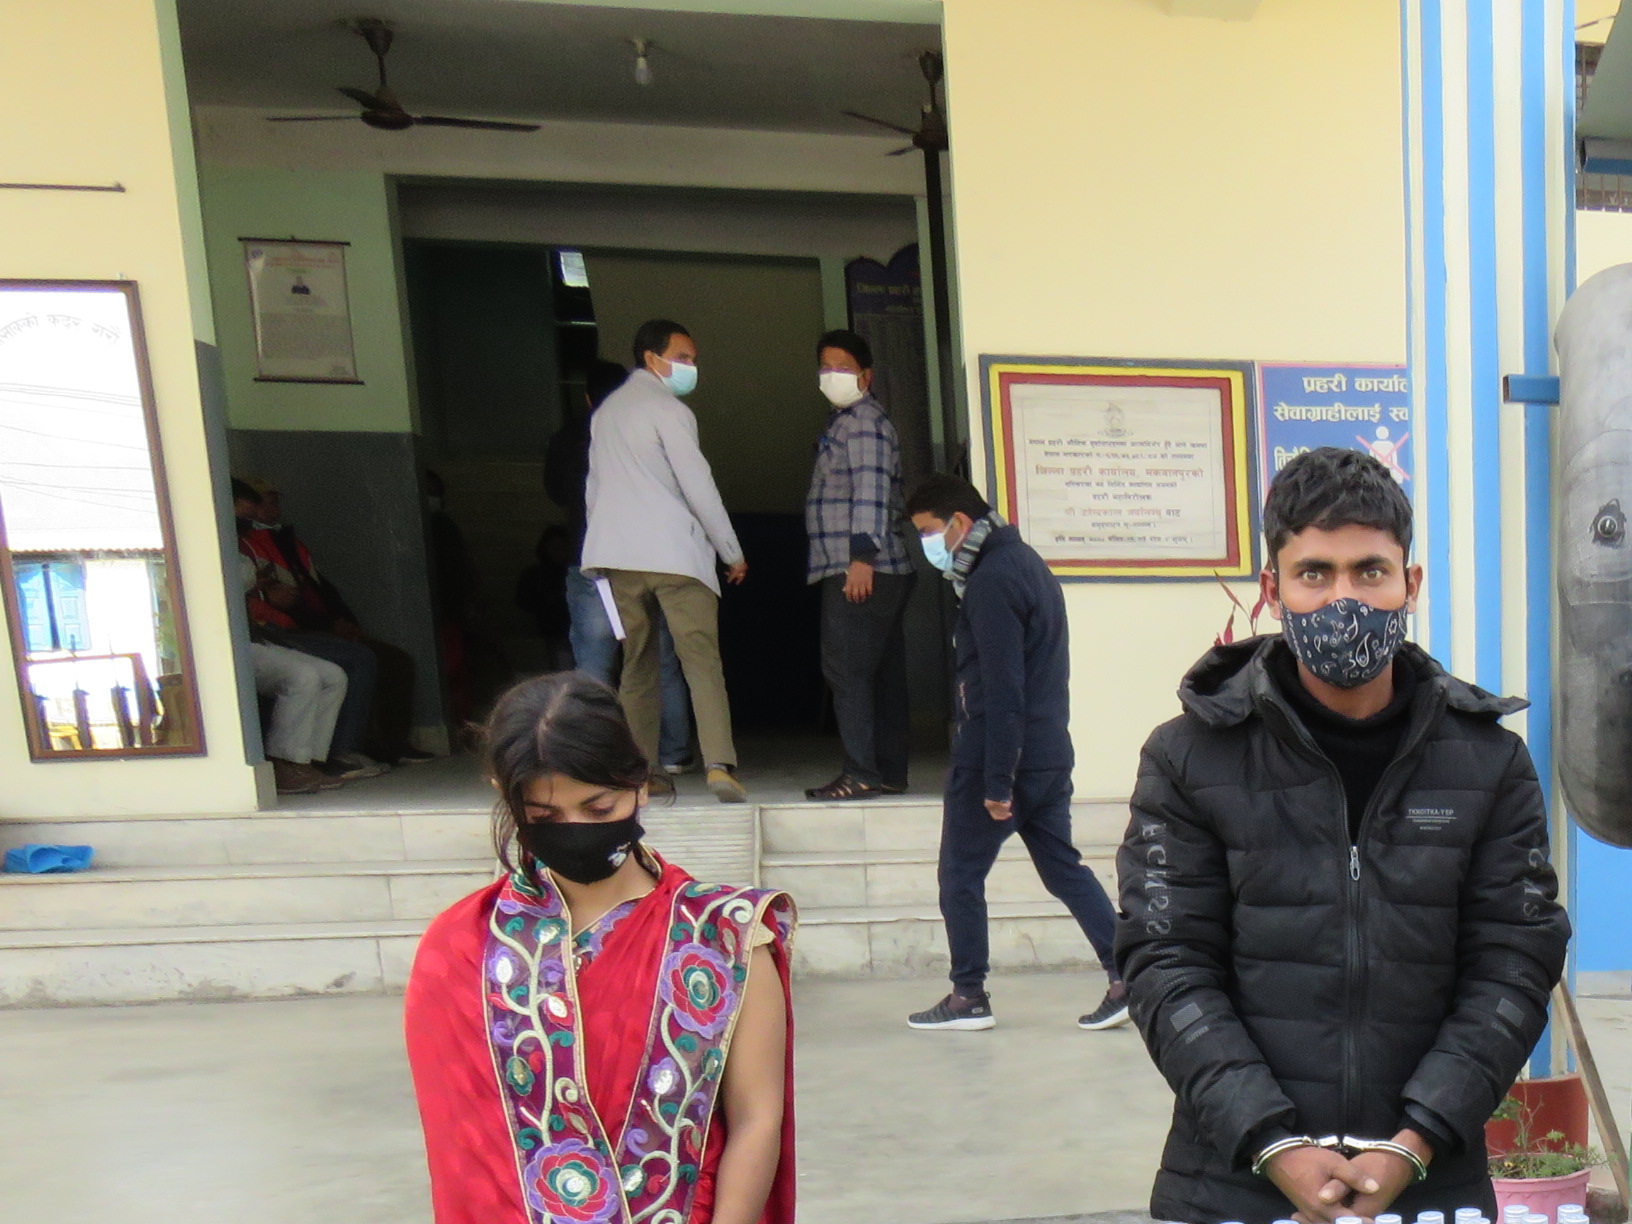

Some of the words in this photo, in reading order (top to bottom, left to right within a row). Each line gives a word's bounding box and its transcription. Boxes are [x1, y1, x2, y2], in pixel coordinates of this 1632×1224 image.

[1302, 373, 1347, 393] प्रहरी
[1273, 402, 1381, 423] सेवाग्राहीलाई
[1389, 406, 1408, 422] स्व
[1069, 464, 1093, 477] प्रहरी
